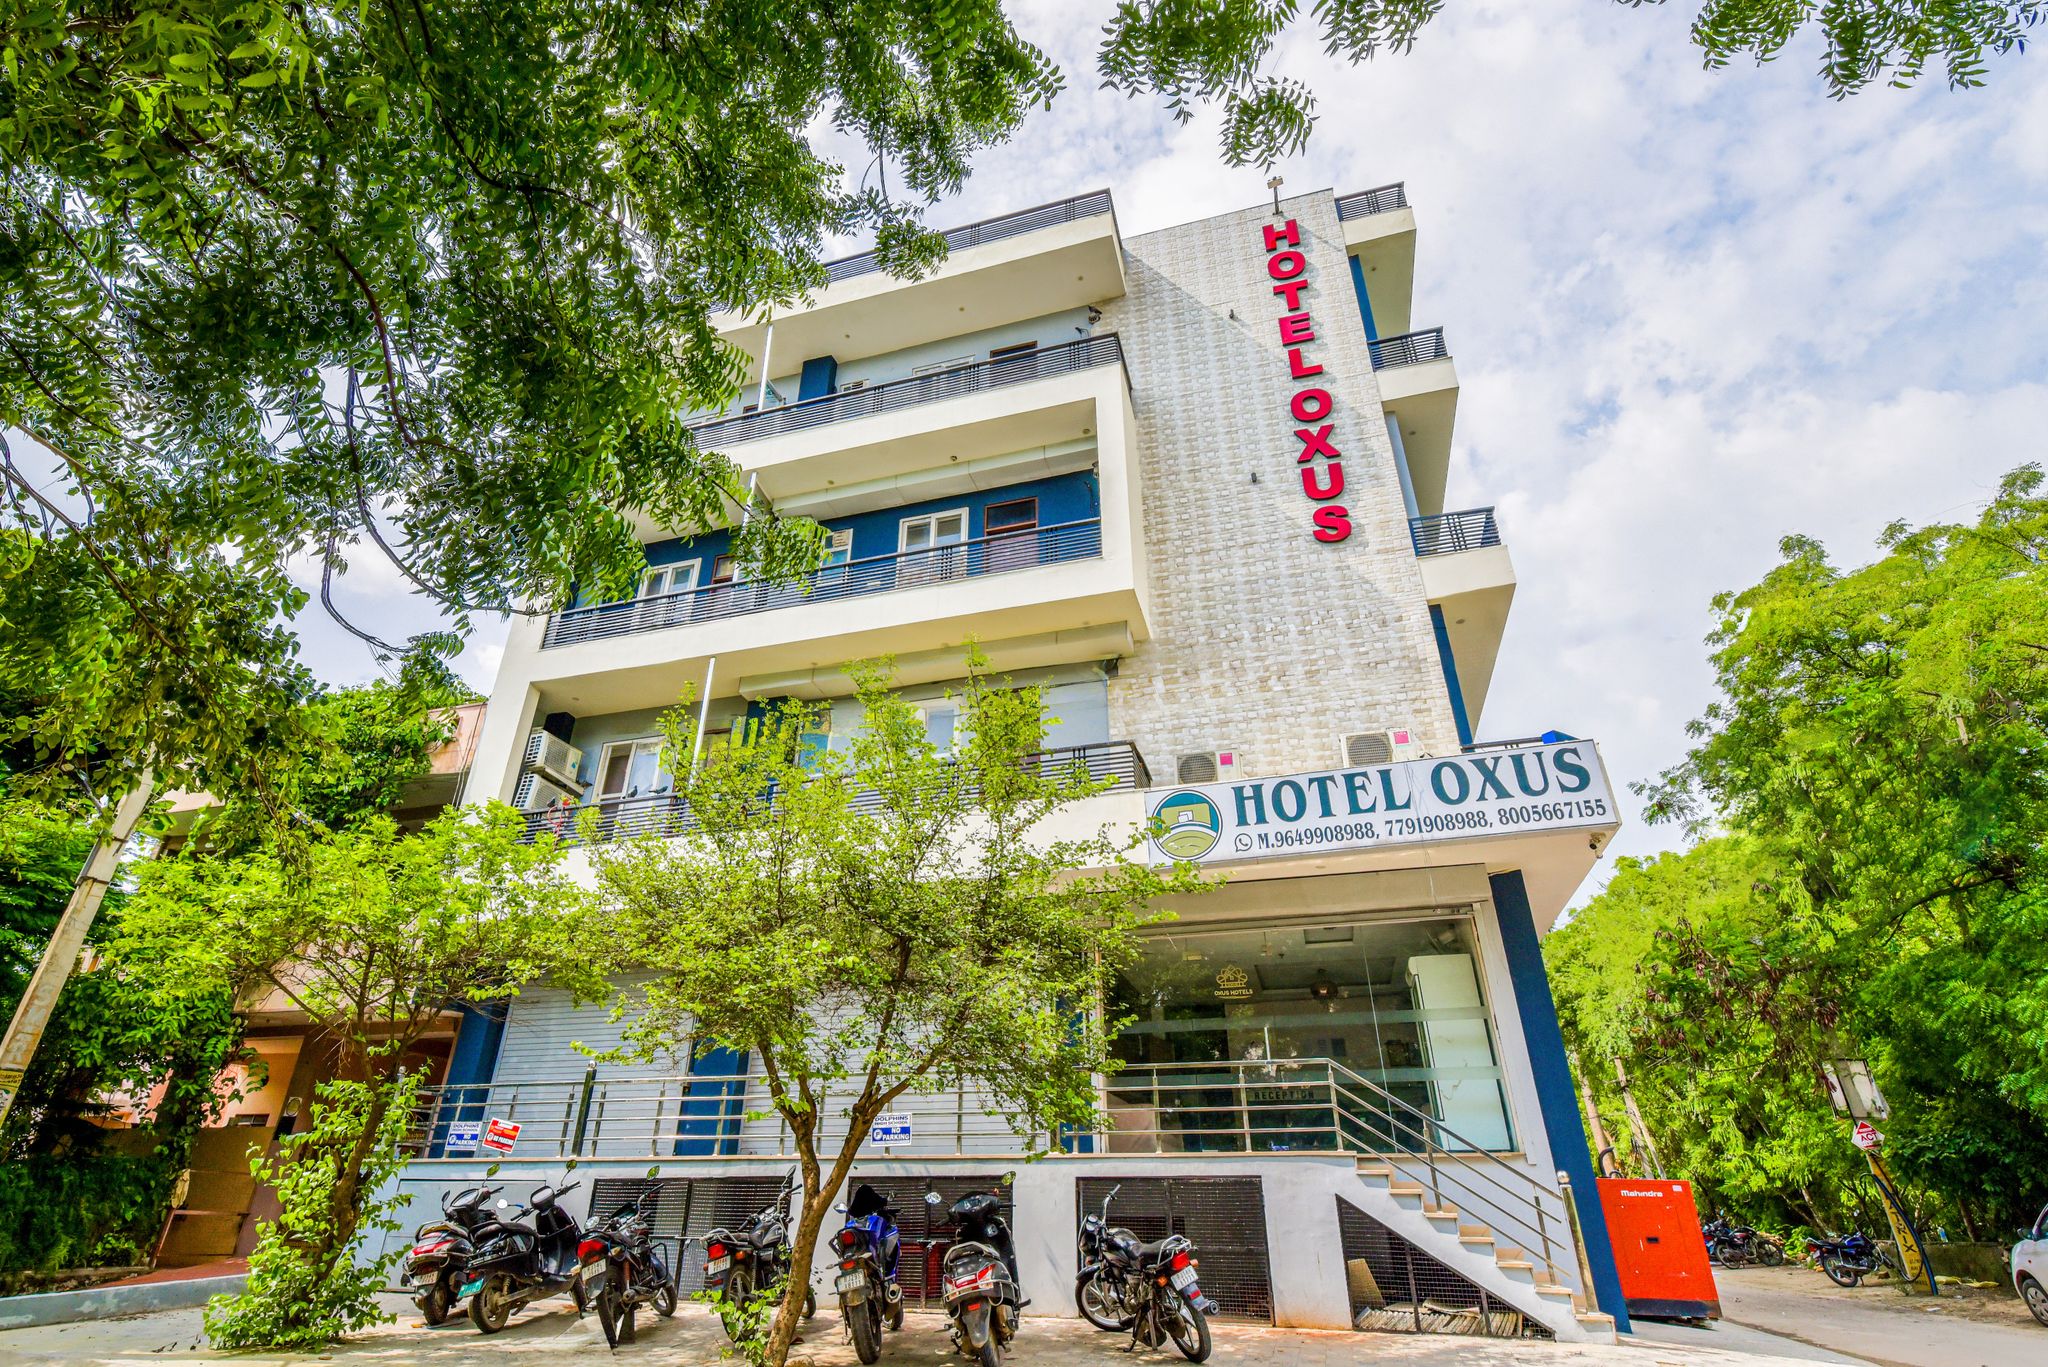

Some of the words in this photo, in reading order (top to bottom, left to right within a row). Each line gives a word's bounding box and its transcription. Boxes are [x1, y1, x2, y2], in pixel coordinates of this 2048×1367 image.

[1262, 218, 1324, 380] HOTEL
[1290, 388, 1352, 543] OXUS
[1231, 768, 1412, 827] HOTEL
[1431, 747, 1591, 806] OXUS
[1498, 799, 1607, 826] 8005667155
[1254, 1089, 1314, 1100] RECEPTION
